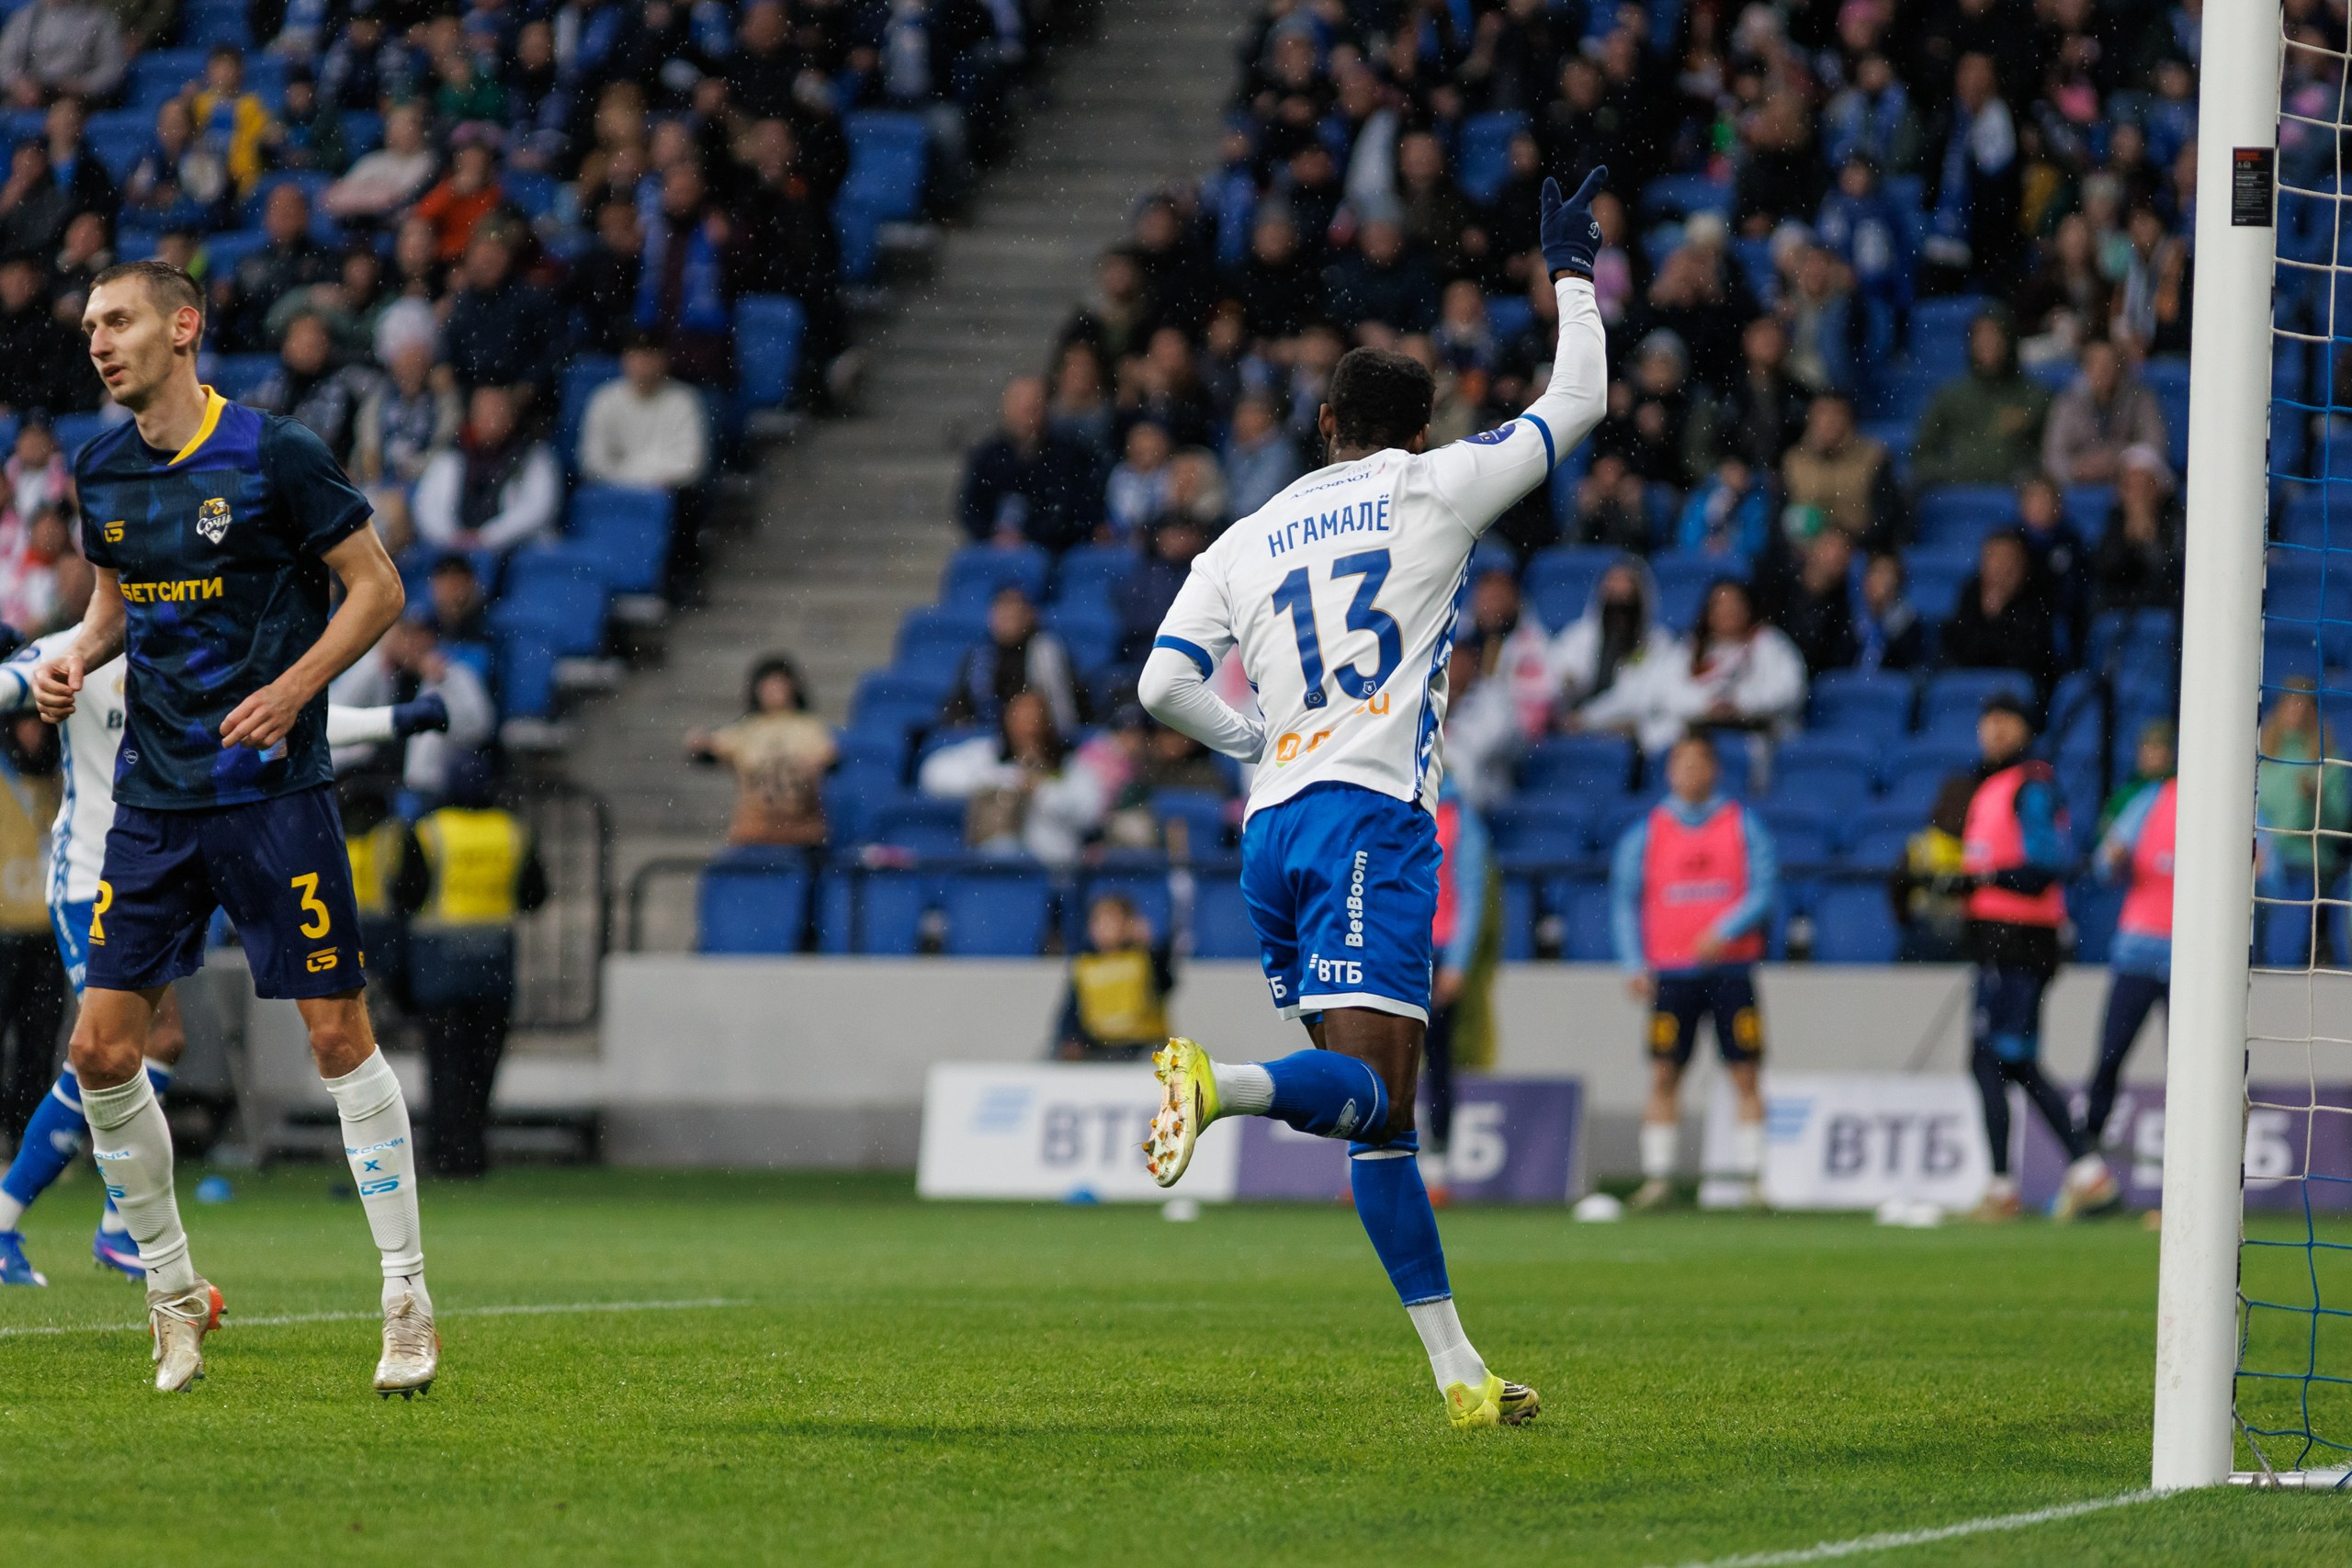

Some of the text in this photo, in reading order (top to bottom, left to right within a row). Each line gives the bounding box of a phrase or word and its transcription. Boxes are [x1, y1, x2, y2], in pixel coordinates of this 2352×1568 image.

[1267, 493, 1390, 558] НГАМАЛЁ
[120, 577, 223, 602] БЕТСИТИ
[1272, 547, 1404, 710] 13
[291, 872, 331, 939] 3
[1345, 850, 1368, 947] BetBoom
[1317, 959, 1363, 985] ВТБ
[1823, 1111, 1967, 1179] ВТБ
